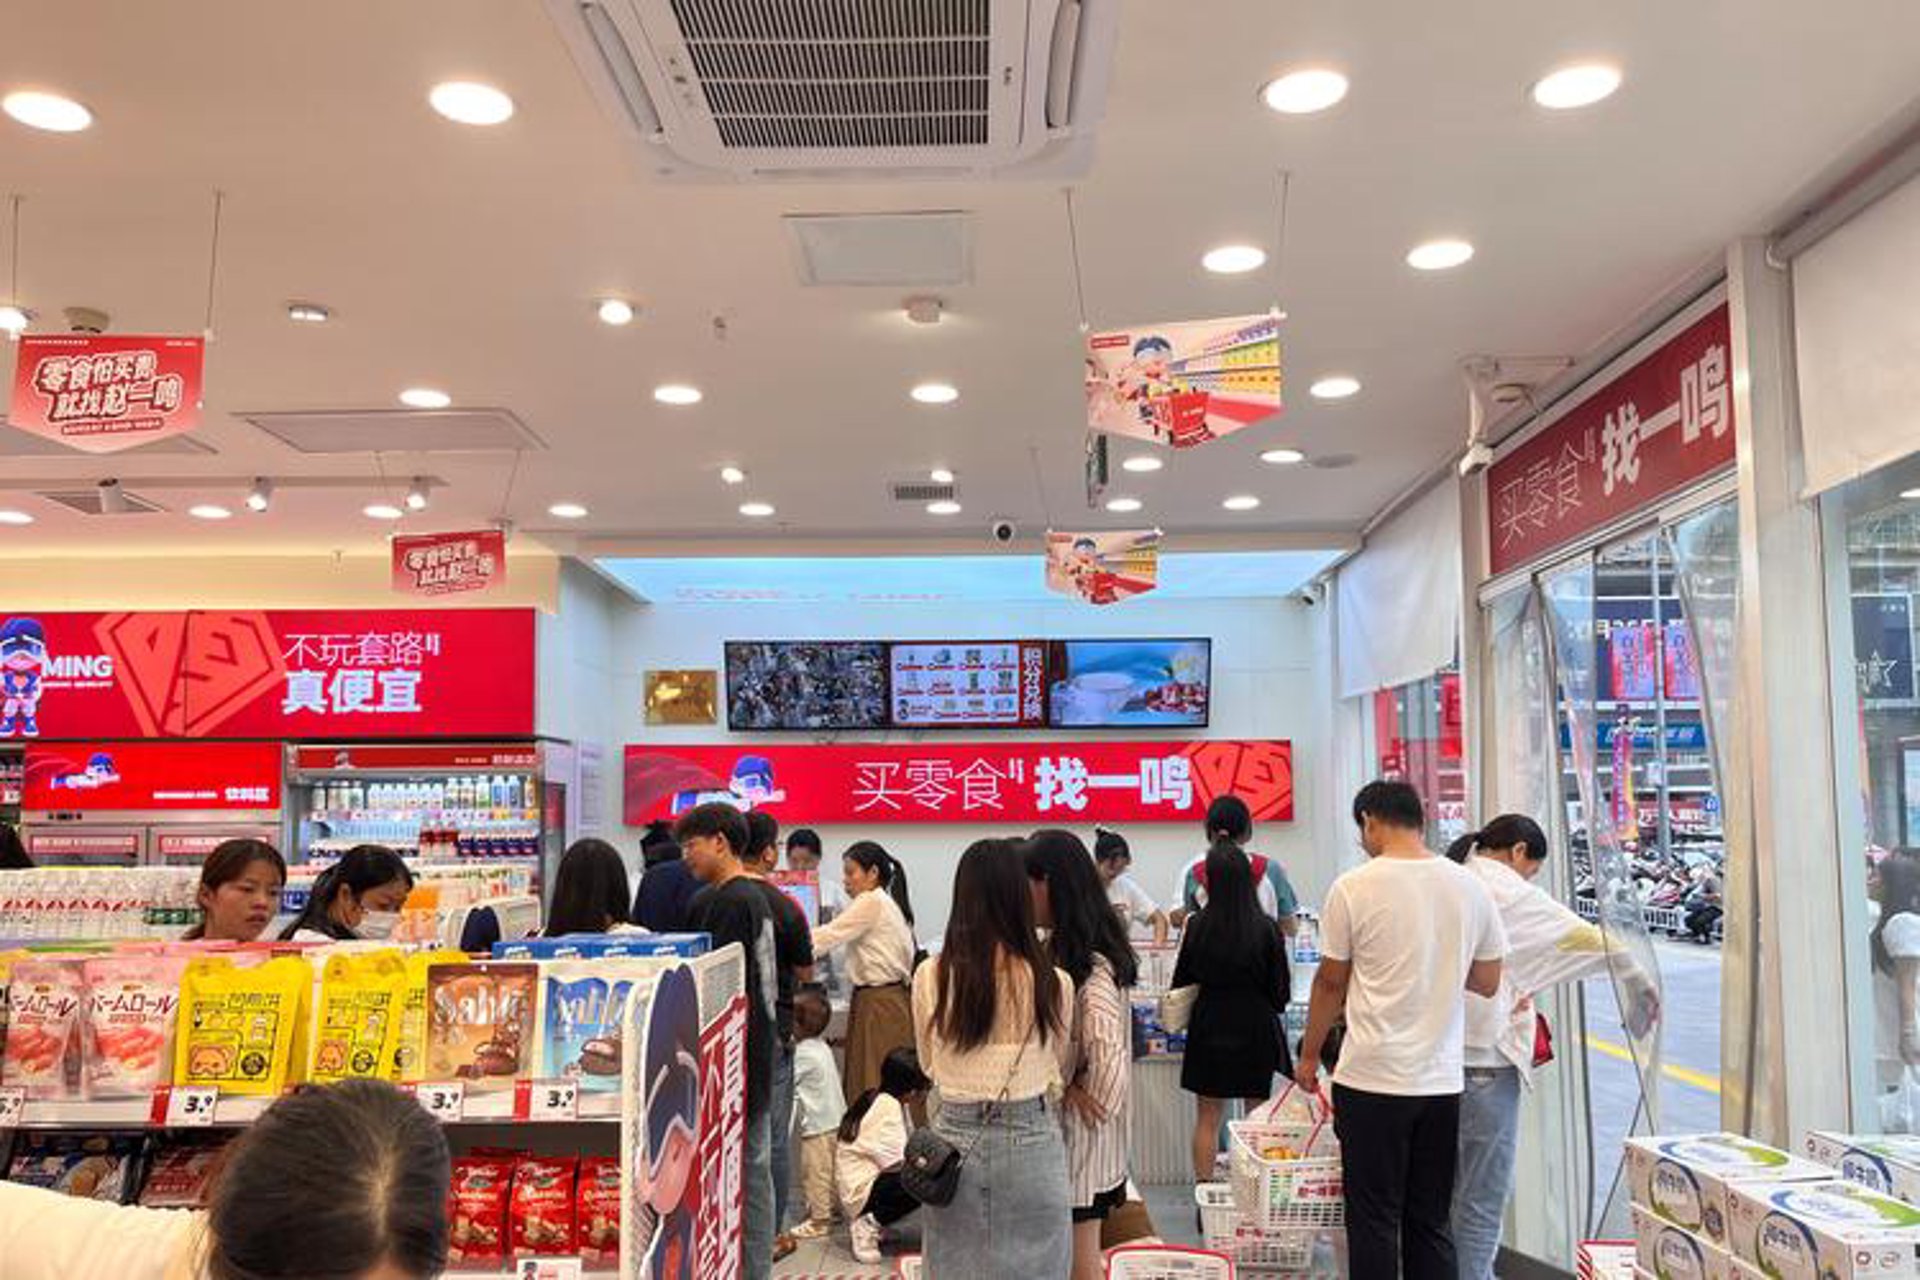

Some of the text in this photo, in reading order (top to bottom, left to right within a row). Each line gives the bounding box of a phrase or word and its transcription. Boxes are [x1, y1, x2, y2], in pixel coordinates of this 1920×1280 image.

[281, 668, 422, 715] 真便宜
[184, 1095, 213, 1113] 3.9
[432, 1092, 459, 1109] 3.9
[547, 1090, 574, 1108] 3.9
